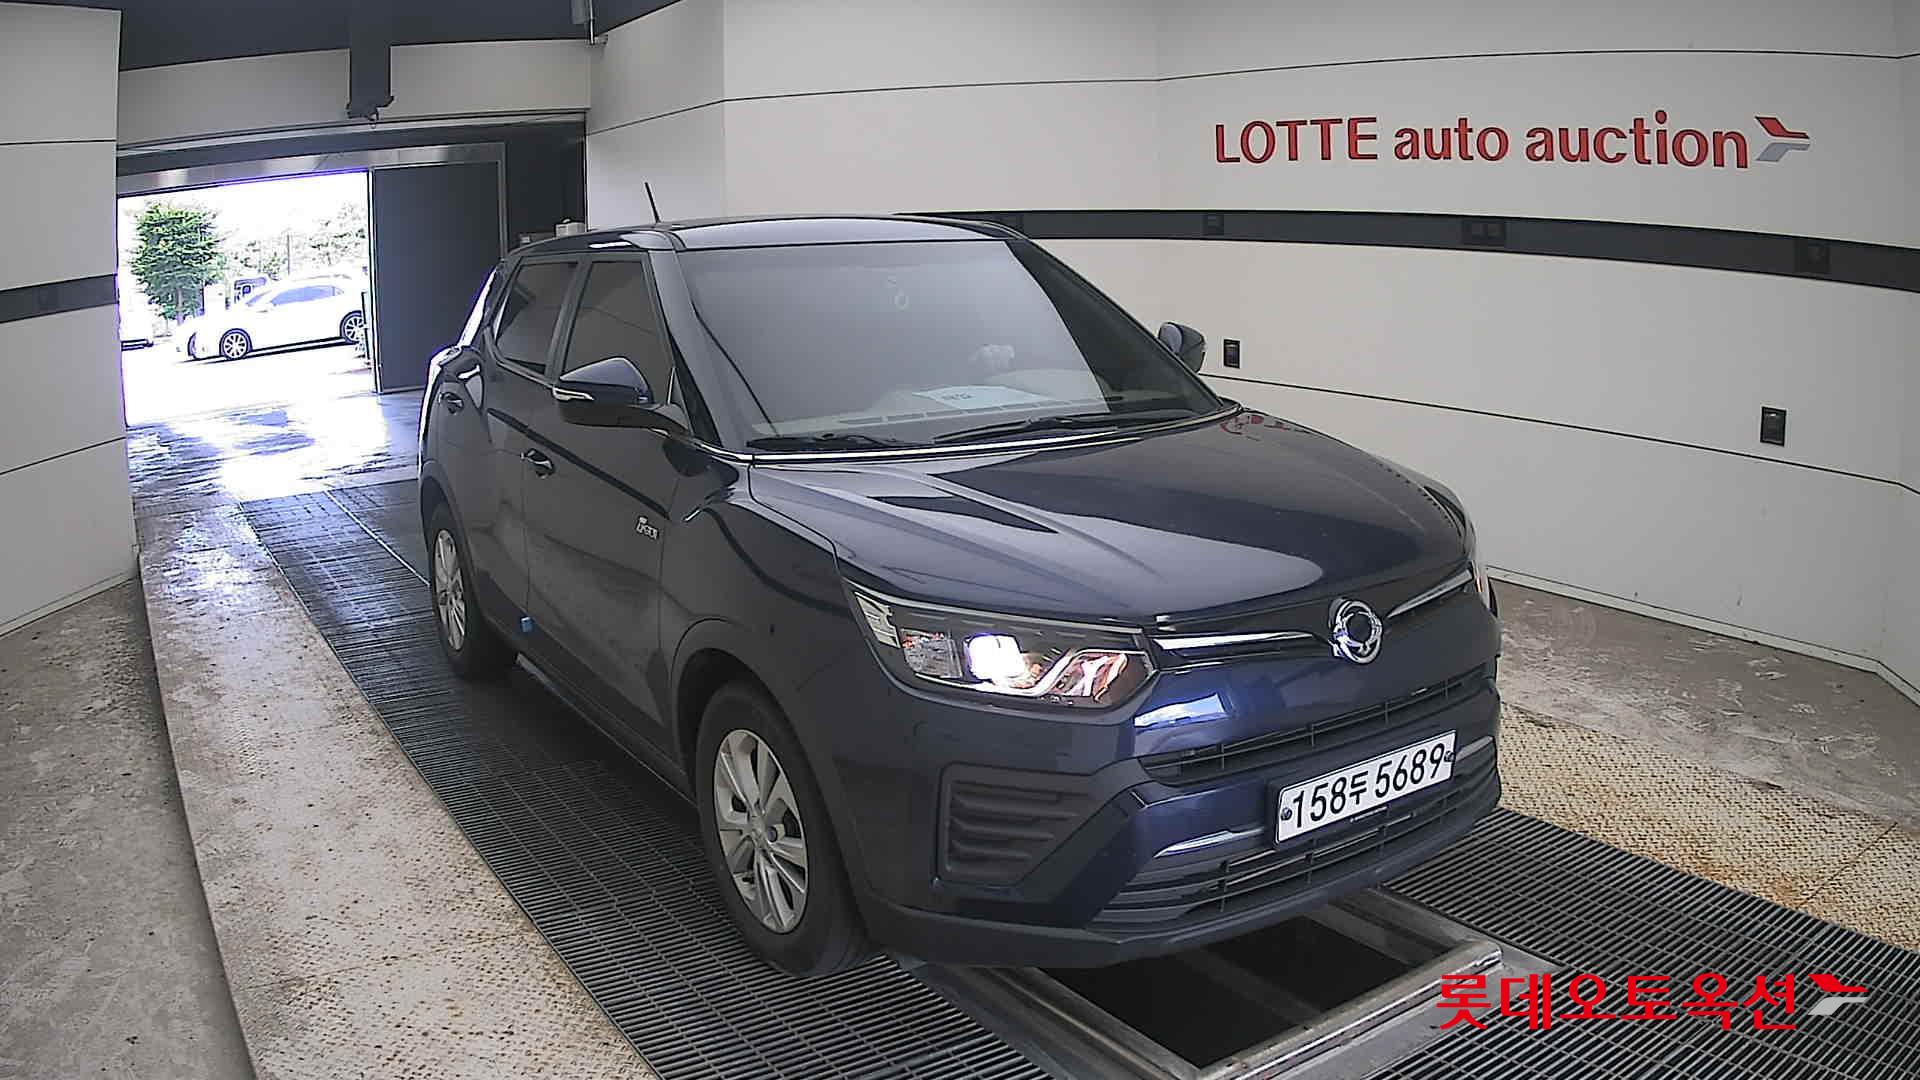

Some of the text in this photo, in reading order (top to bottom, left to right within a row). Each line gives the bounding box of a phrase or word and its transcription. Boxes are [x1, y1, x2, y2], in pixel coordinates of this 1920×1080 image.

[1215, 110, 1749, 169] LOTTE auto auction
[1293, 742, 1445, 828] 158두 5689
